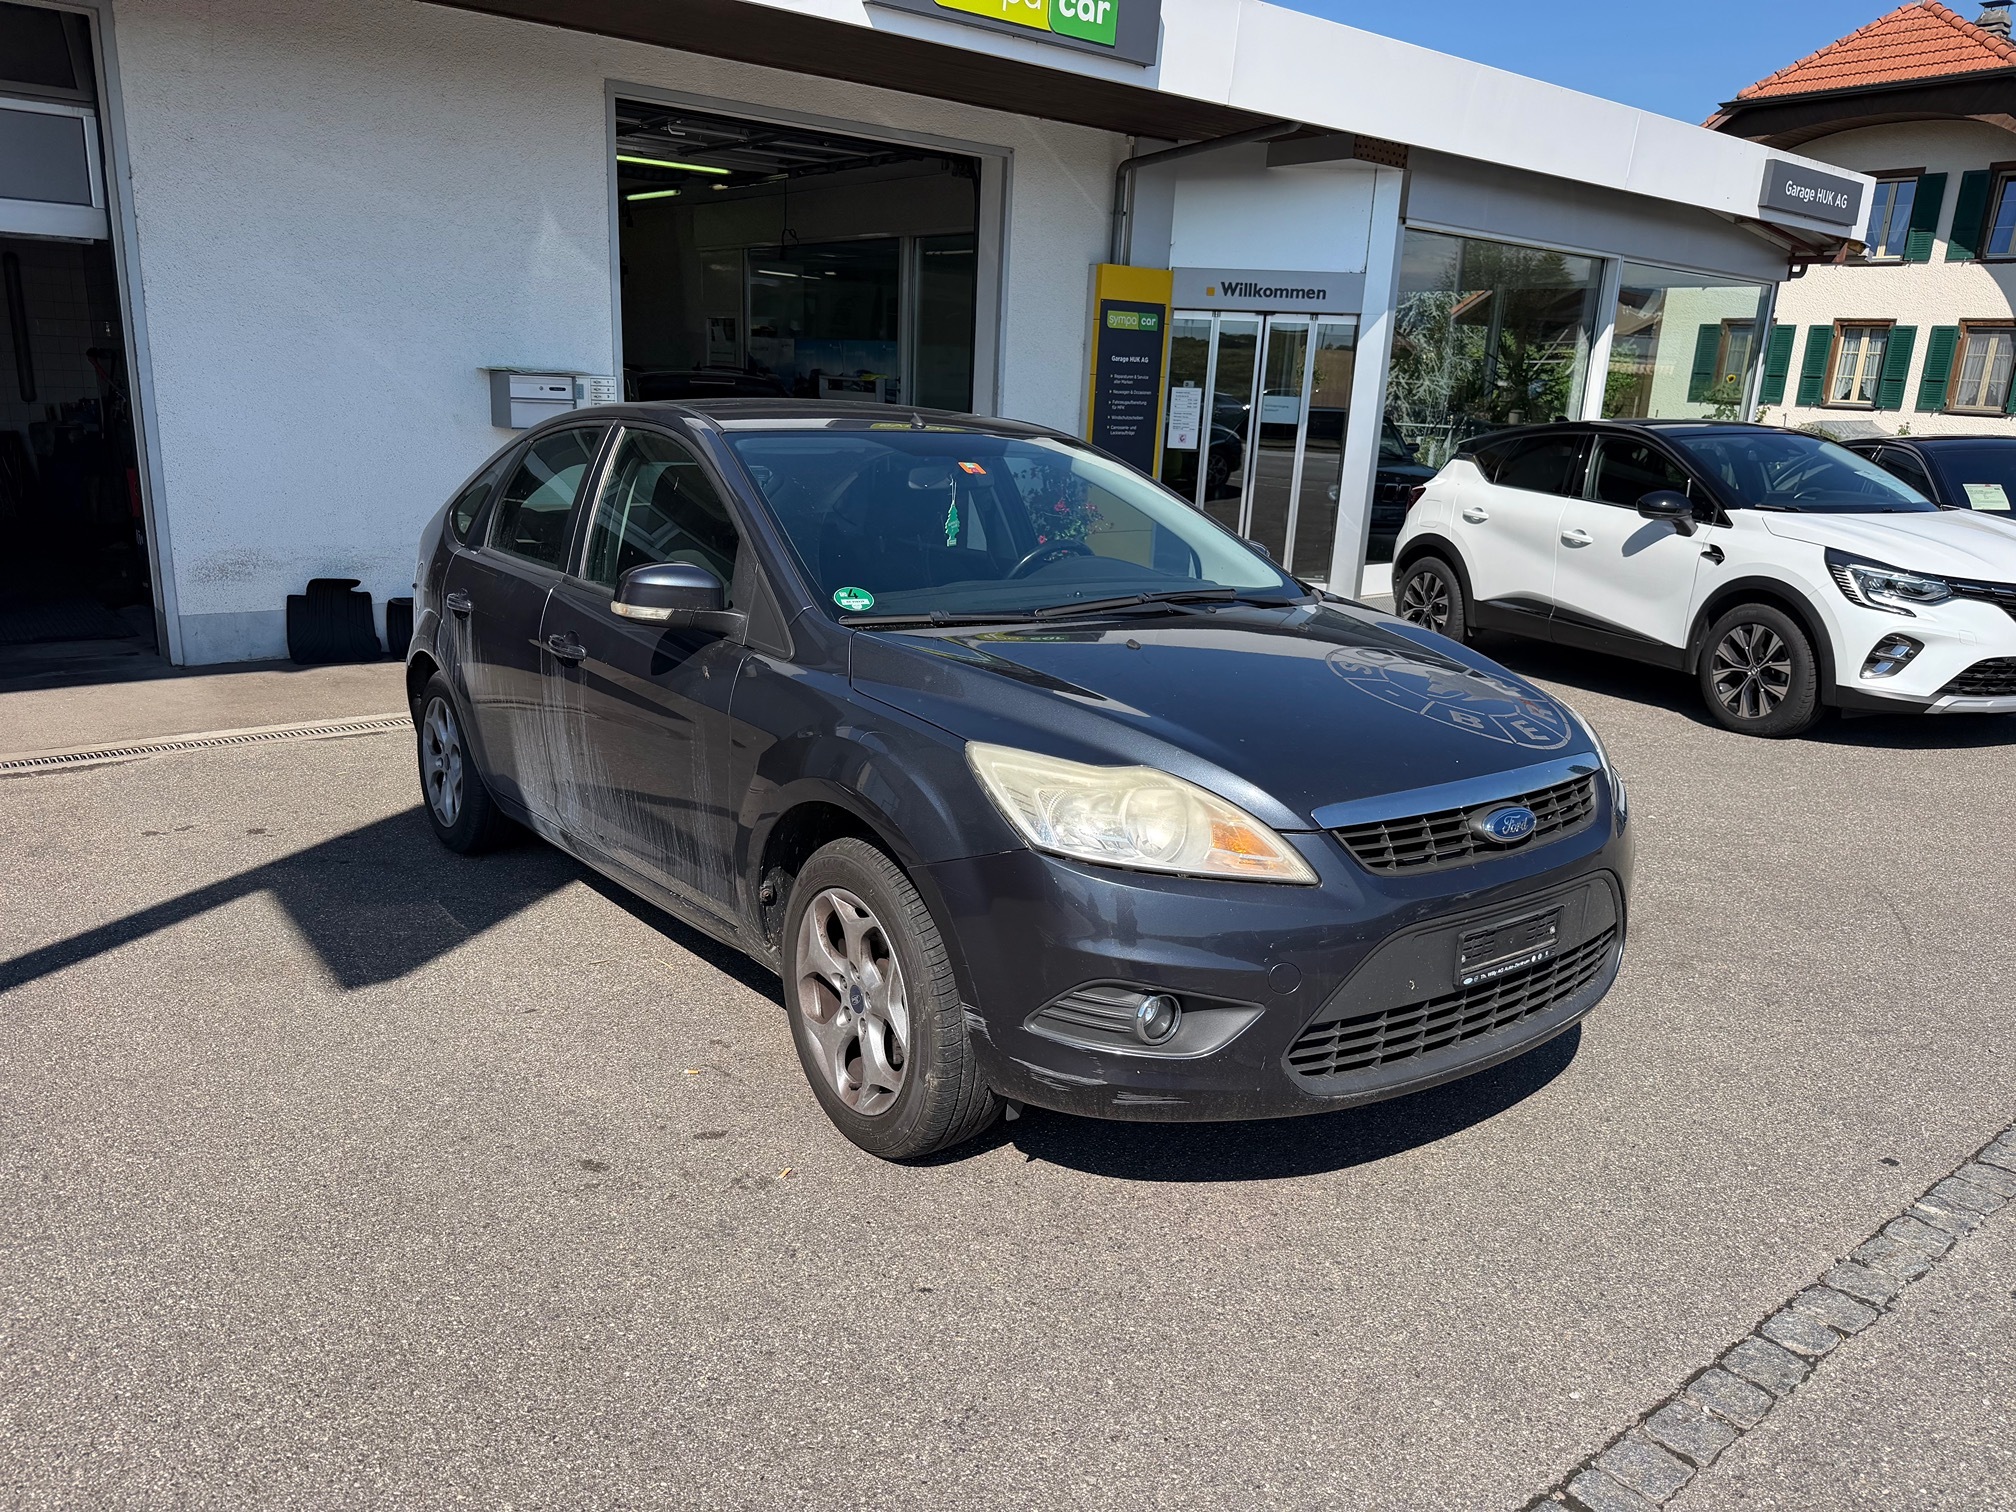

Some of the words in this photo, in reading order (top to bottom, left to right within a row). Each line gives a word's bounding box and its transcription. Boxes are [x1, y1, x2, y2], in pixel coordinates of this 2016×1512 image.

[1059, 0, 1111, 24] car
[1785, 180, 1815, 202] Garage
[1816, 188, 1835, 206] HUK
[1835, 193, 1848, 209] AG
[1221, 282, 1327, 300] Willkommen
[1109, 315, 1137, 327] sympa
[1141, 317, 1156, 326] car
[1111, 355, 1129, 363] Garage
[848, 588, 858, 599] 4
[1502, 815, 1529, 834] Ford
